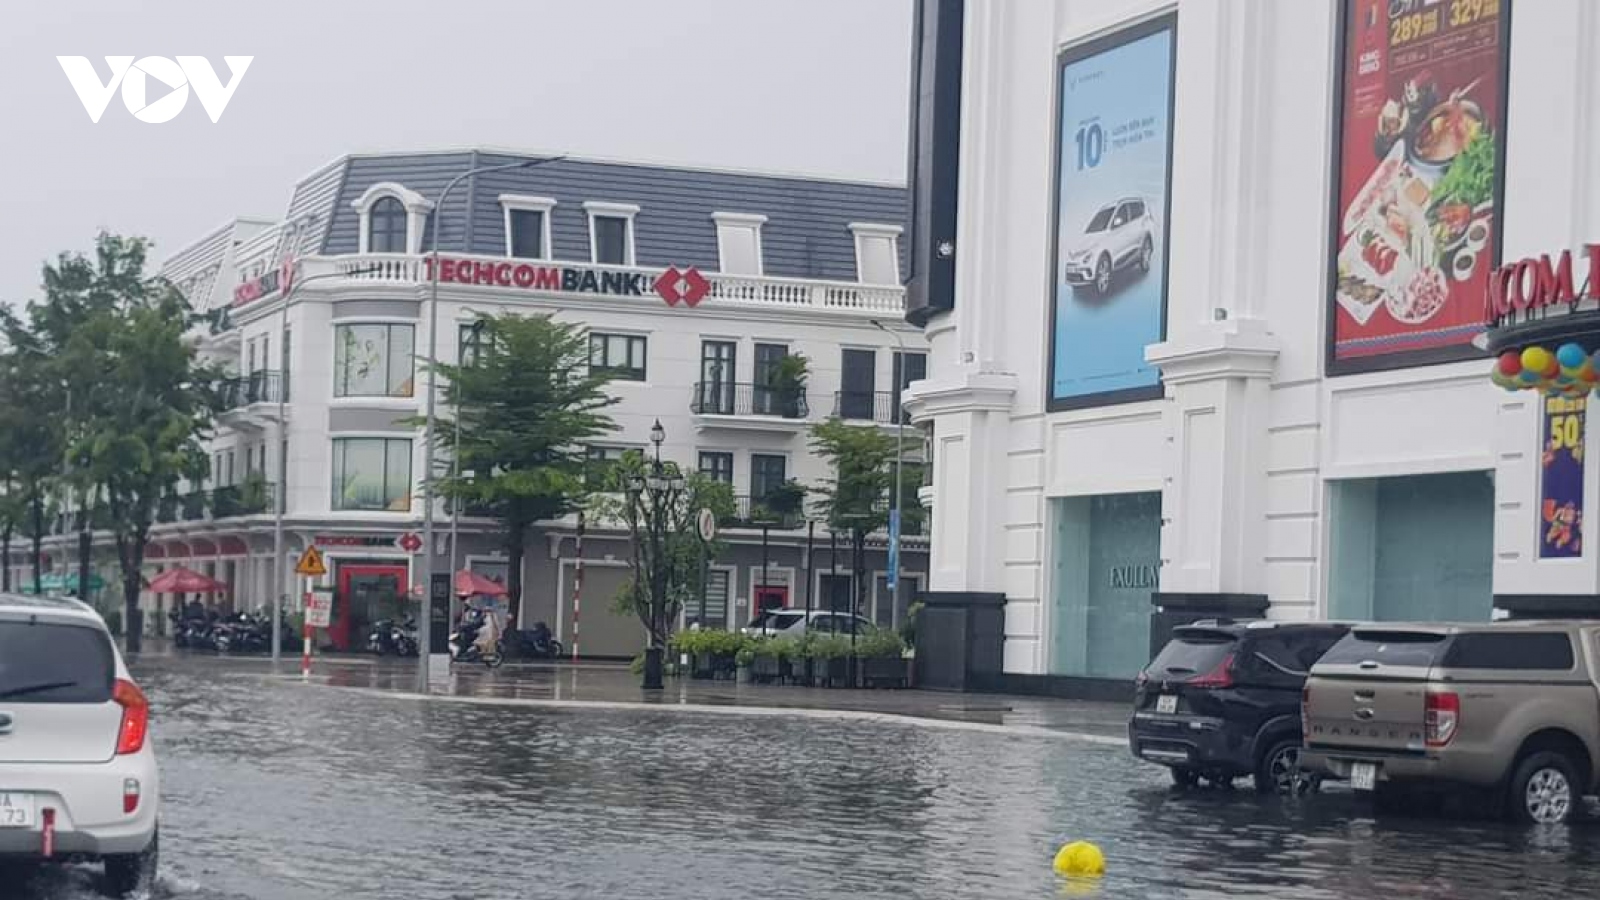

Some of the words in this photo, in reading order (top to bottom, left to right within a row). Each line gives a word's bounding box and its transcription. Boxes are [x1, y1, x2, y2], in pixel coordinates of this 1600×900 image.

[1390, 14, 1422, 46] 289
[1451, 0, 1483, 26] 329
[1076, 123, 1103, 170] 10
[424, 257, 643, 295] TECHCOMBANK
[1550, 414, 1580, 450] 50
